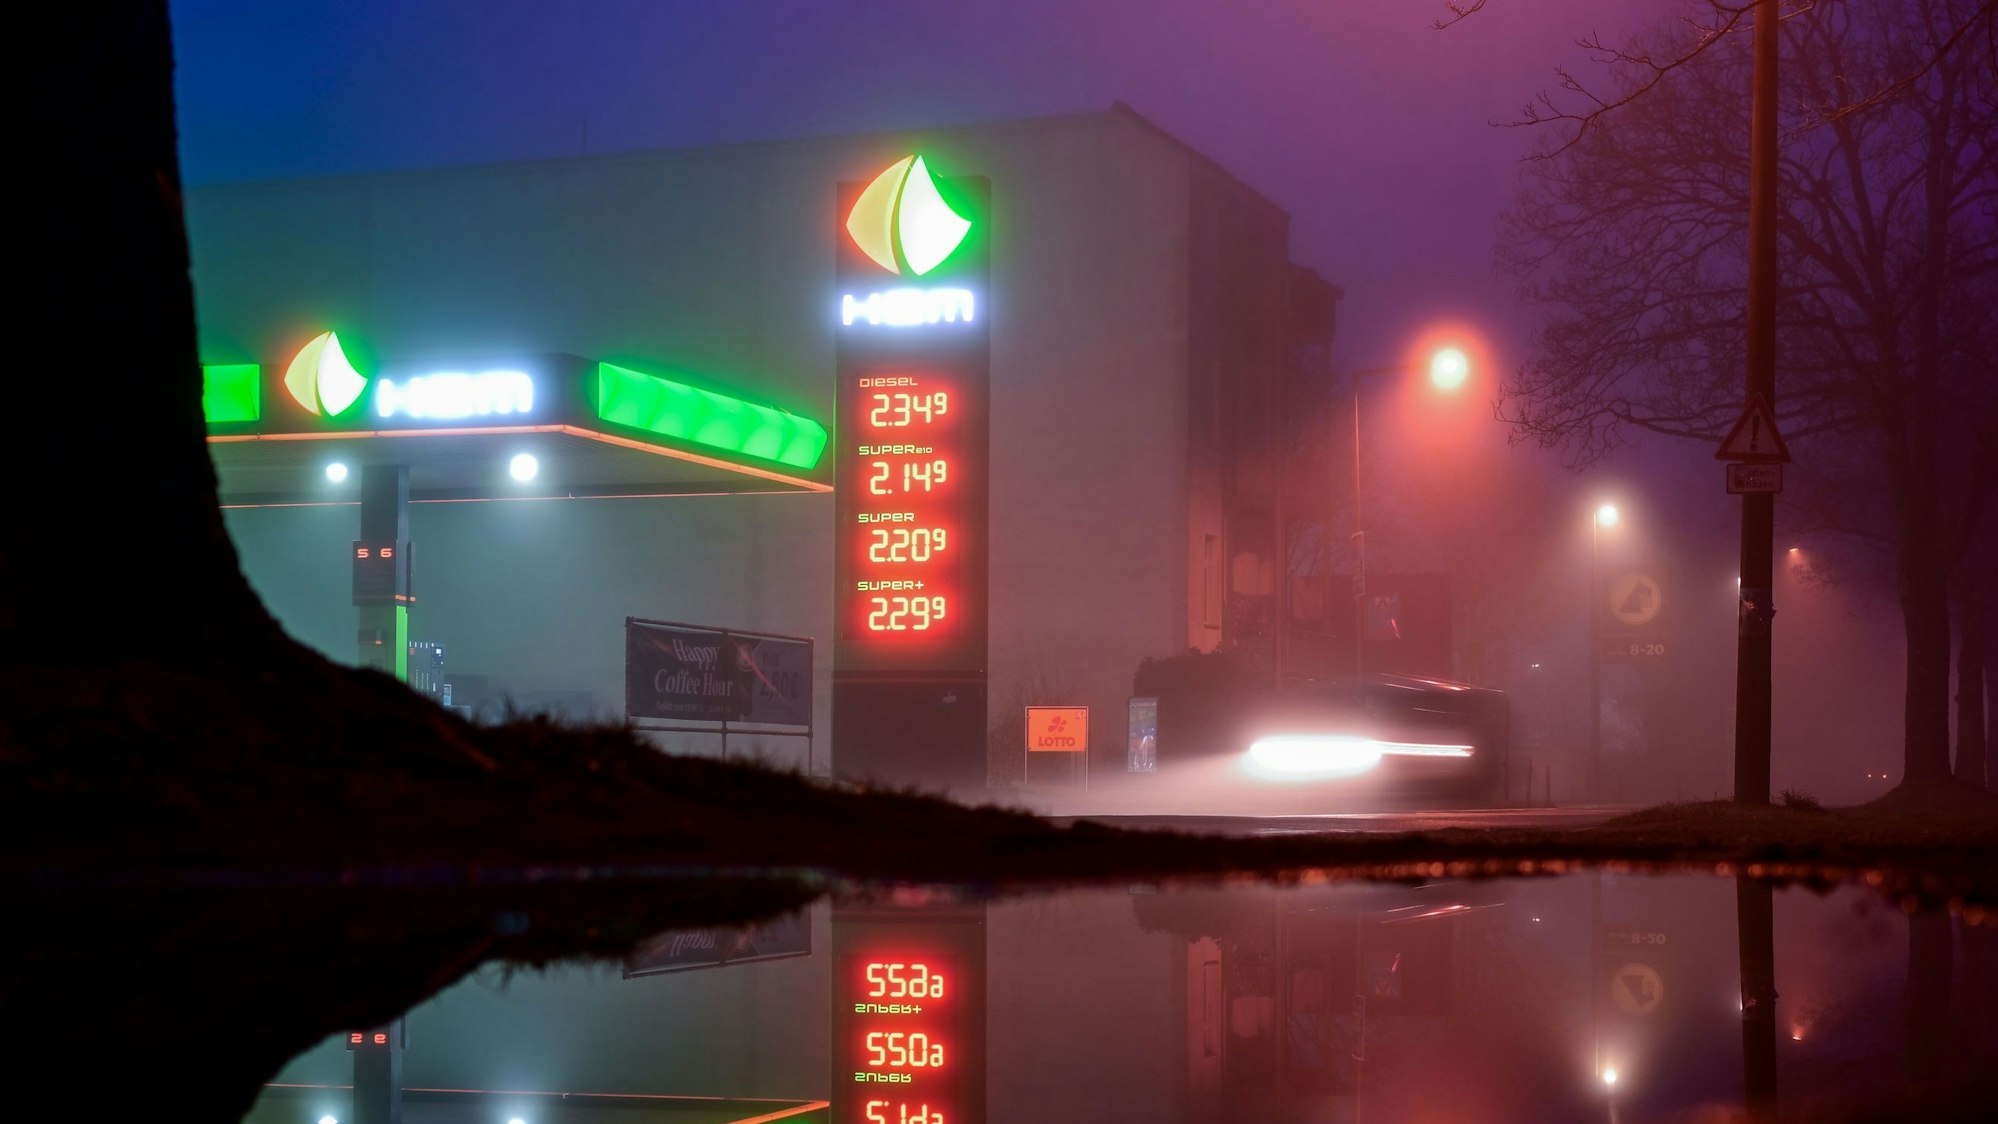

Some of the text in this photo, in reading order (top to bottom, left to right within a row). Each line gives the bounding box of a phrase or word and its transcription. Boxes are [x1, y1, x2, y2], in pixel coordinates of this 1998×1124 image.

[859, 377, 918, 388] DIESEL
[870, 392, 948, 427] 2.349
[858, 444, 915, 456] SUPER
[870, 460, 947, 495] 2.149
[857, 512, 915, 523] SUPER
[869, 528, 946, 562] 2.209
[357, 548, 392, 558] 5 6
[857, 581, 924, 591] SUPER+
[869, 596, 945, 631] 2.299
[672, 638, 720, 670] Happy
[1629, 644, 1665, 656] 8-20
[654, 668, 734, 697] Coffee Hour
[1038, 736, 1076, 748] LOTTO
